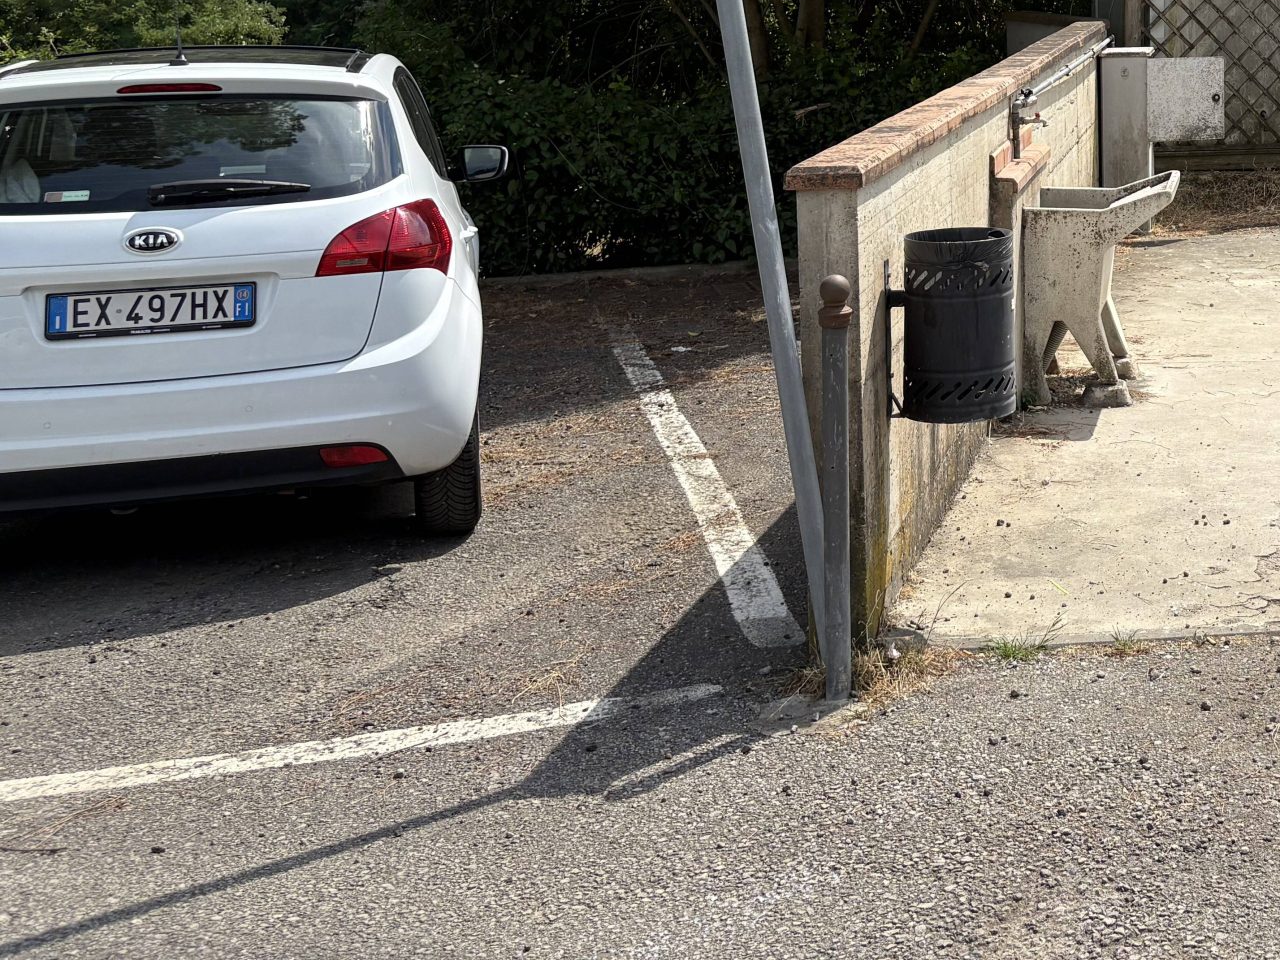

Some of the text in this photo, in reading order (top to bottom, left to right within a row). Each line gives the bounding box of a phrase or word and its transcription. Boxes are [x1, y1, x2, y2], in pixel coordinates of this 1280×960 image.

[134, 234, 169, 248] KIA
[72, 289, 229, 328] EX 497HX
[236, 302, 248, 316] FI
[55, 316, 60, 329] I
